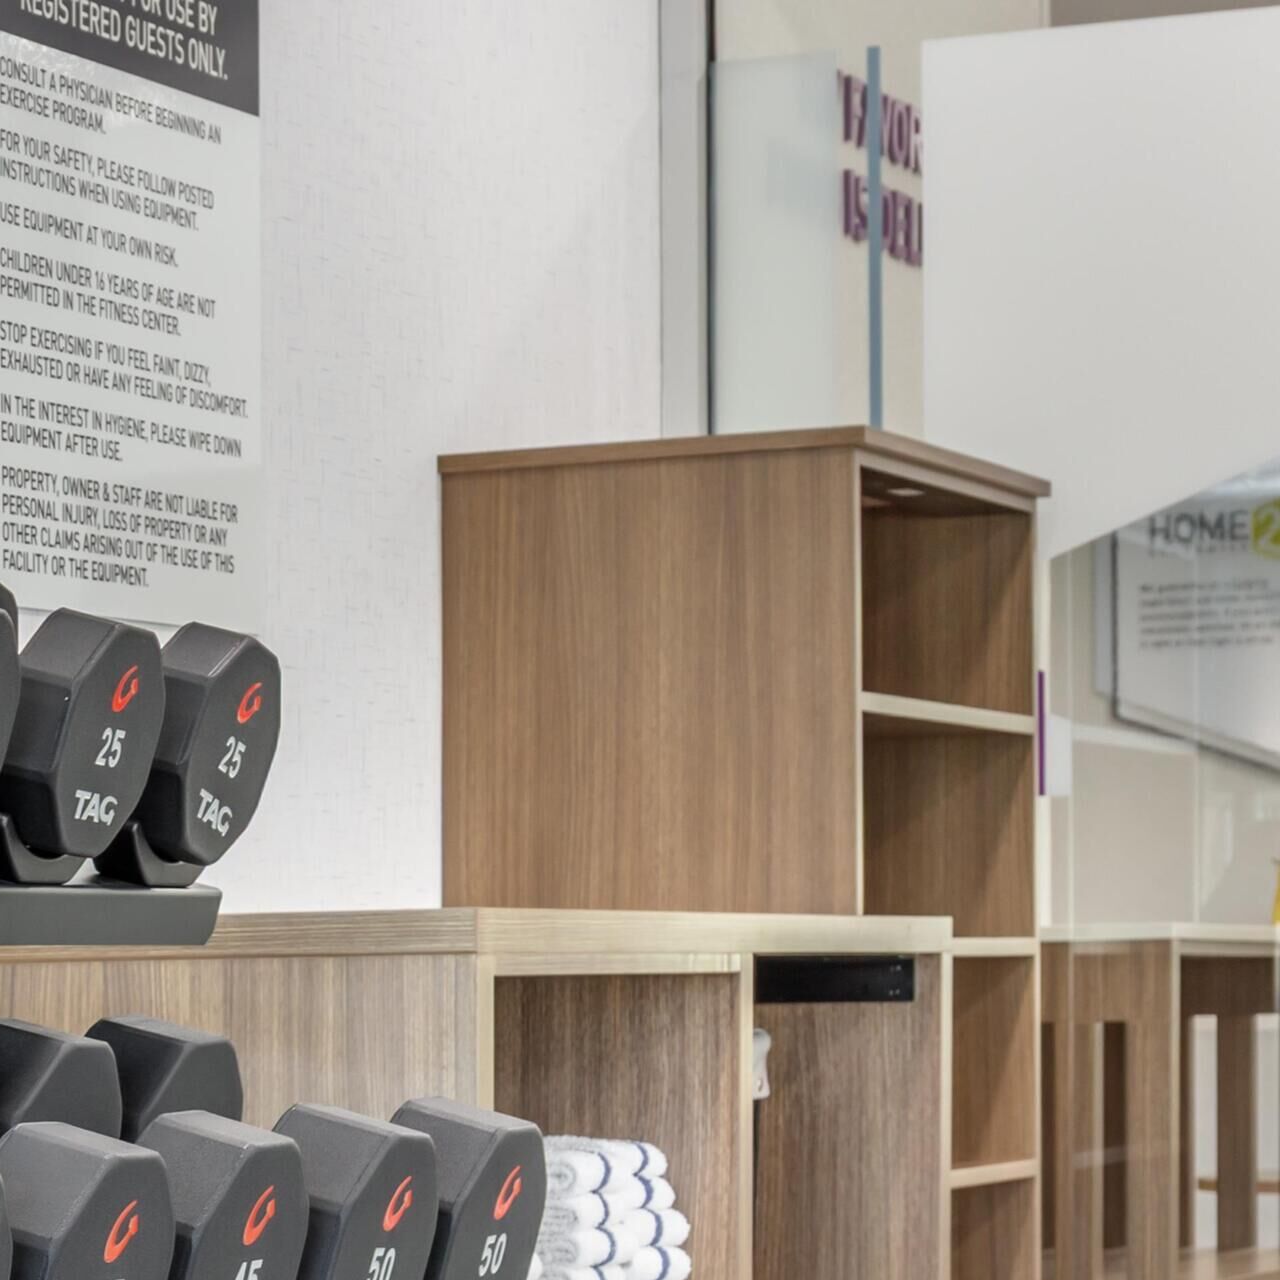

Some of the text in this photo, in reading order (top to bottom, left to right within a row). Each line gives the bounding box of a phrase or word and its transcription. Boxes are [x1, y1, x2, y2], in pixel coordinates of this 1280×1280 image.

[125, 15, 229, 81] GUESTS ONLY.
[0, 82, 105, 134] EXERCISE PROGRAM.
[48, 71, 56, 91] A
[58, 74, 112, 110] PHYSICIAN
[115, 92, 152, 122] BEFORE
[155, 105, 205, 139] BEGINNING
[208, 123, 221, 144] AN
[0, 128, 214, 210] FOR YOUR SAFETY, PLEASE FOLLOW POSTED
[0, 156, 198, 231] INSTRUCTIONS WHEN USING EQUIPMENT.
[0, 201, 177, 267] USE EQUIPMENT AT YOUR OWN RISK.
[0, 246, 214, 318] CHILDREN UNDER 16 YEARS OF AGE ARE NOT
[0, 273, 180, 336] PERMITTED IN THE FITNESS CENTER.
[0, 319, 210, 386] STOP EXERCISING IF YOU FEEL FAINT, DIZZY,
[0, 347, 247, 418] EXHAUSTED OR HAVE ANY FEELING OF DISCOMFORT.
[0, 393, 241, 458] IN THE INTEREST IN HYGIENE, PLEASE WIPE DOWN
[0, 420, 121, 462] EQUIPMENT AFTER USE.
[1, 465, 237, 523] PROPERTY, OWNER & STAFF ARE NOT LIABLE FOR
[1, 493, 226, 546] PERSONAL INJURY, LOSS OF PROPERTY OR ANY
[1, 521, 234, 573] OTHER CLAIMS ARISING OUT OF THE USE OF THIS
[2, 548, 148, 588] FACILITY OR THE EQUIPMENT.
[95, 728, 126, 767] 25
[218, 736, 246, 778] 25
[75, 790, 117, 825] TAG
[197, 788, 232, 836] TAG
[479, 1233, 507, 1276] 50
